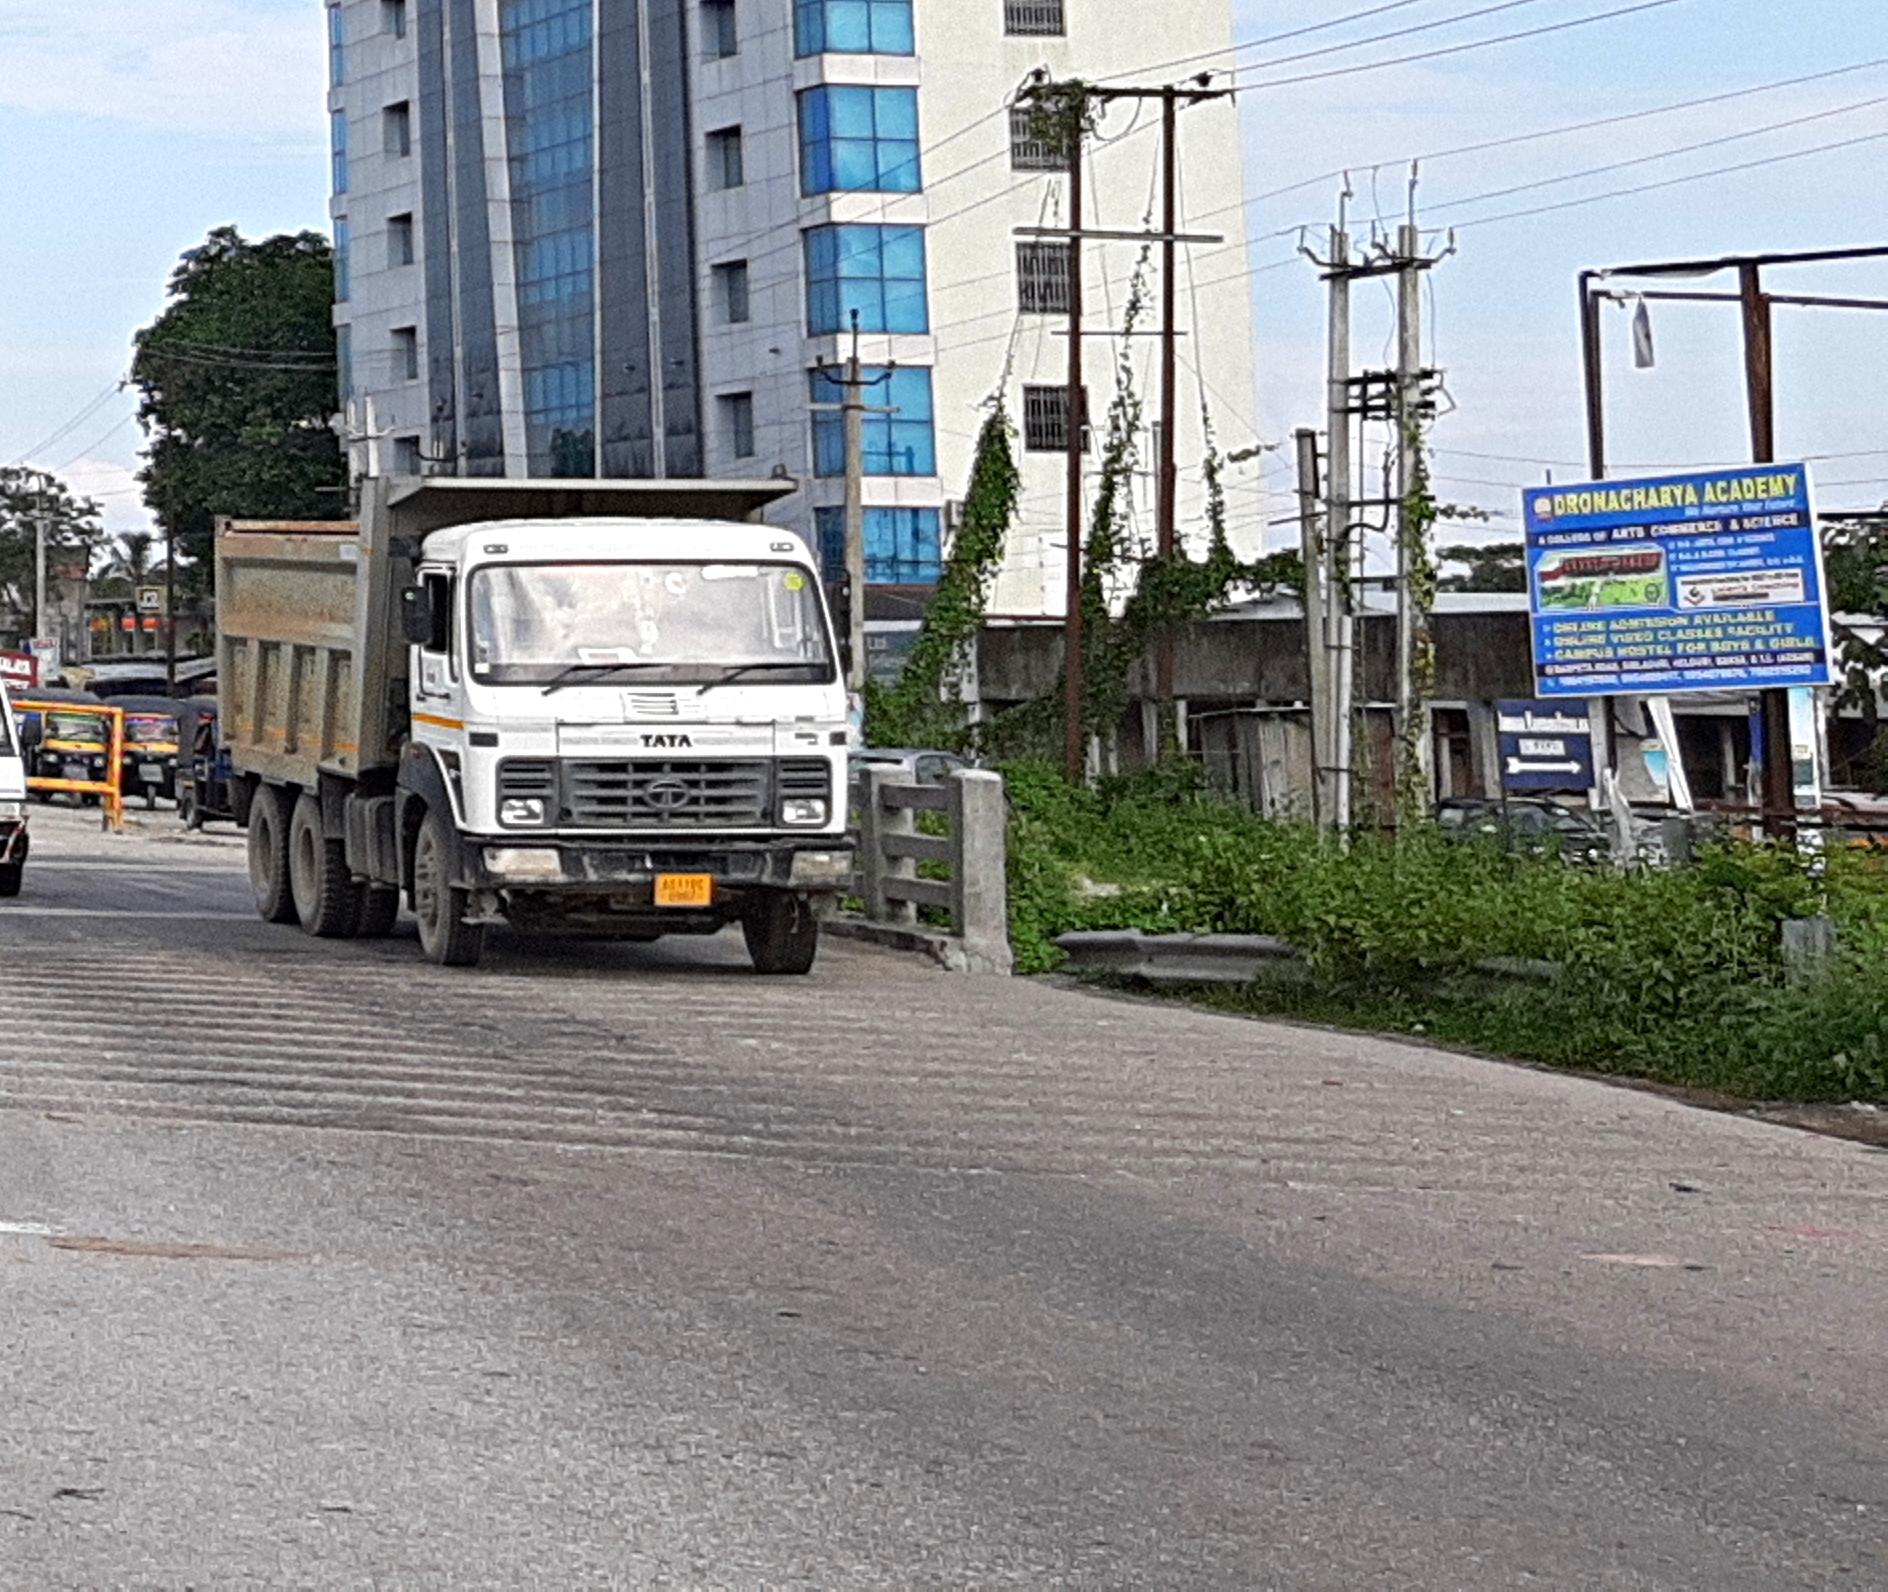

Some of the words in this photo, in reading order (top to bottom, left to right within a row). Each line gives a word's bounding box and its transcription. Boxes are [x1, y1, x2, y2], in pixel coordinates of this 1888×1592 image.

[1554, 483, 1698, 516] DRONACHARYA
[1704, 474, 1798, 503] ACADEMY
[1611, 526, 1645, 540] ARTS
[1742, 512, 1798, 530] SCIENCE
[1609, 615, 1689, 630] ADMISSION
[1693, 609, 1776, 626] AVAILABLE
[1657, 626, 1723, 642] CLASSES
[1554, 646, 1615, 661] CAMPUS
[1617, 642, 1674, 657] HOSTEL
[1677, 641, 1707, 655] FOR
[1710, 639, 1750, 653] BOYS
[1769, 634, 1815, 650] GIRLS
[640, 734, 694, 748] TATA
